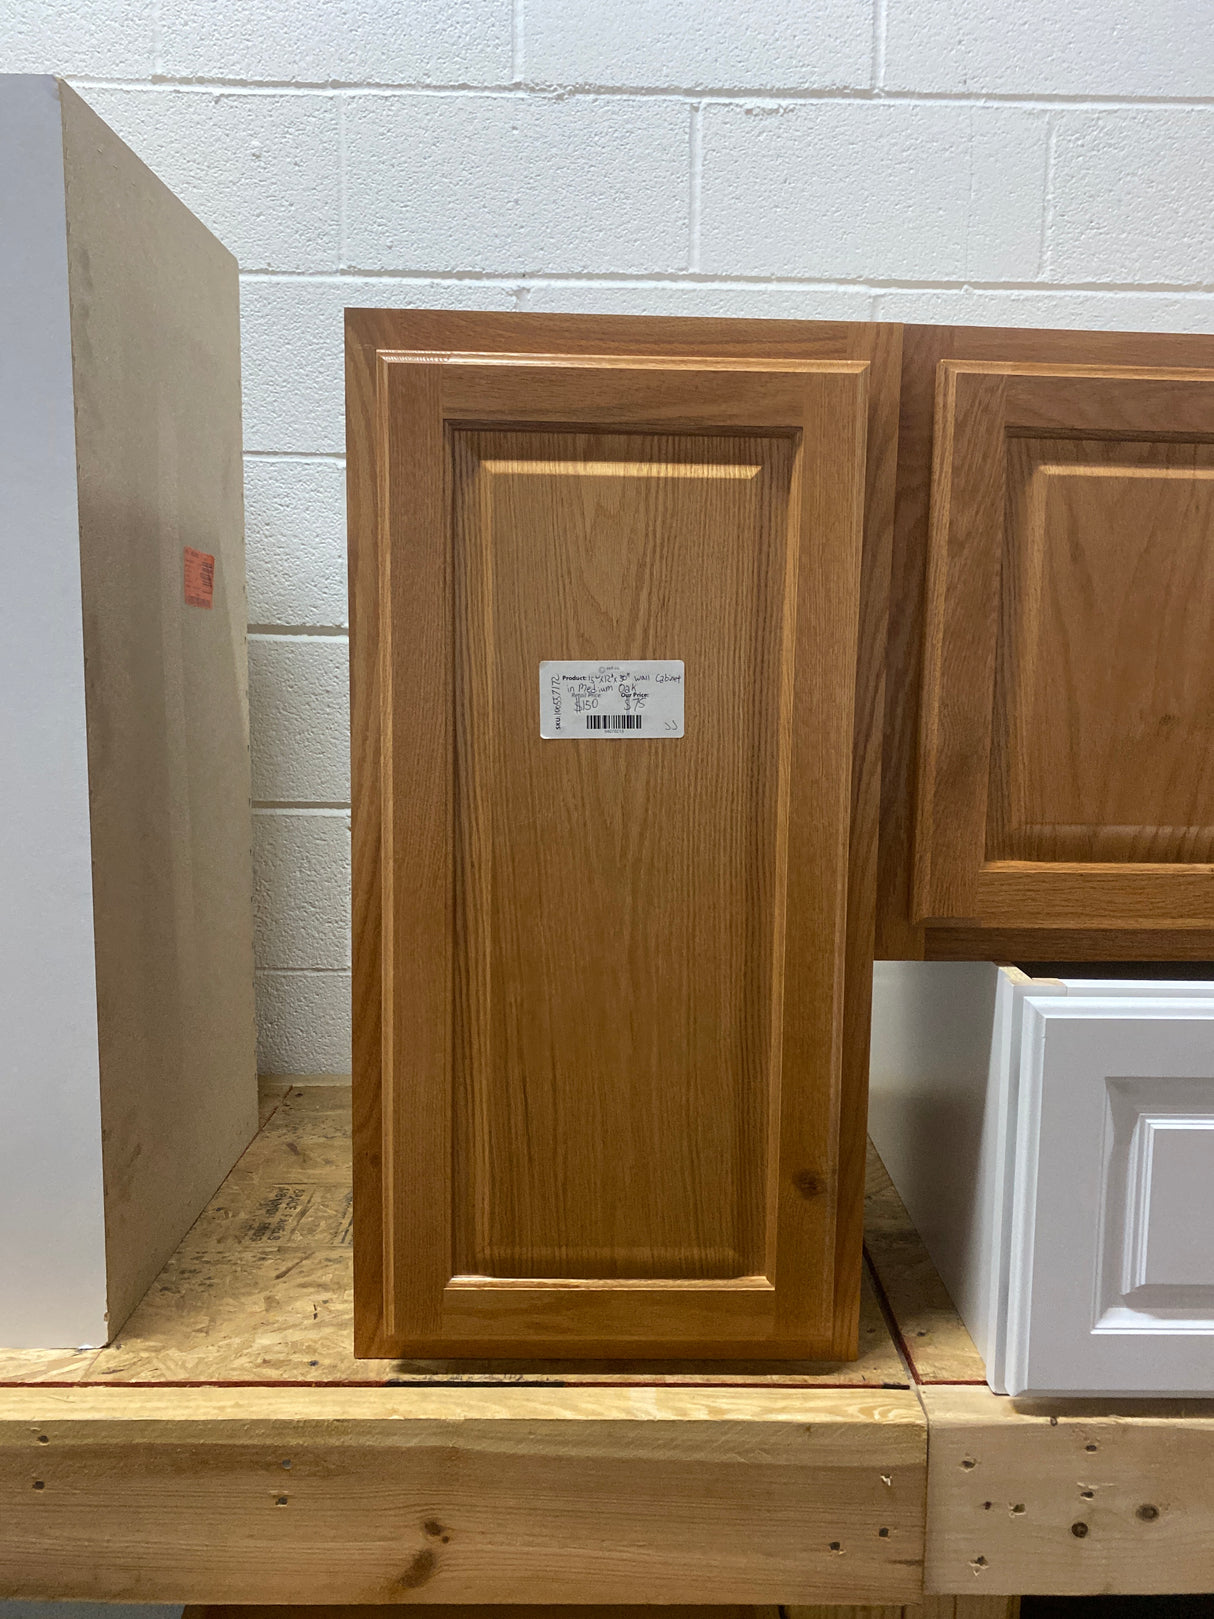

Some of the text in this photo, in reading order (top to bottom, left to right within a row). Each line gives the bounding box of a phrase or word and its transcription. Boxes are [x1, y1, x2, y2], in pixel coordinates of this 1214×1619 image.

[566, 683, 637, 694] in Medium Oak
[573, 697, 599, 714] $150
